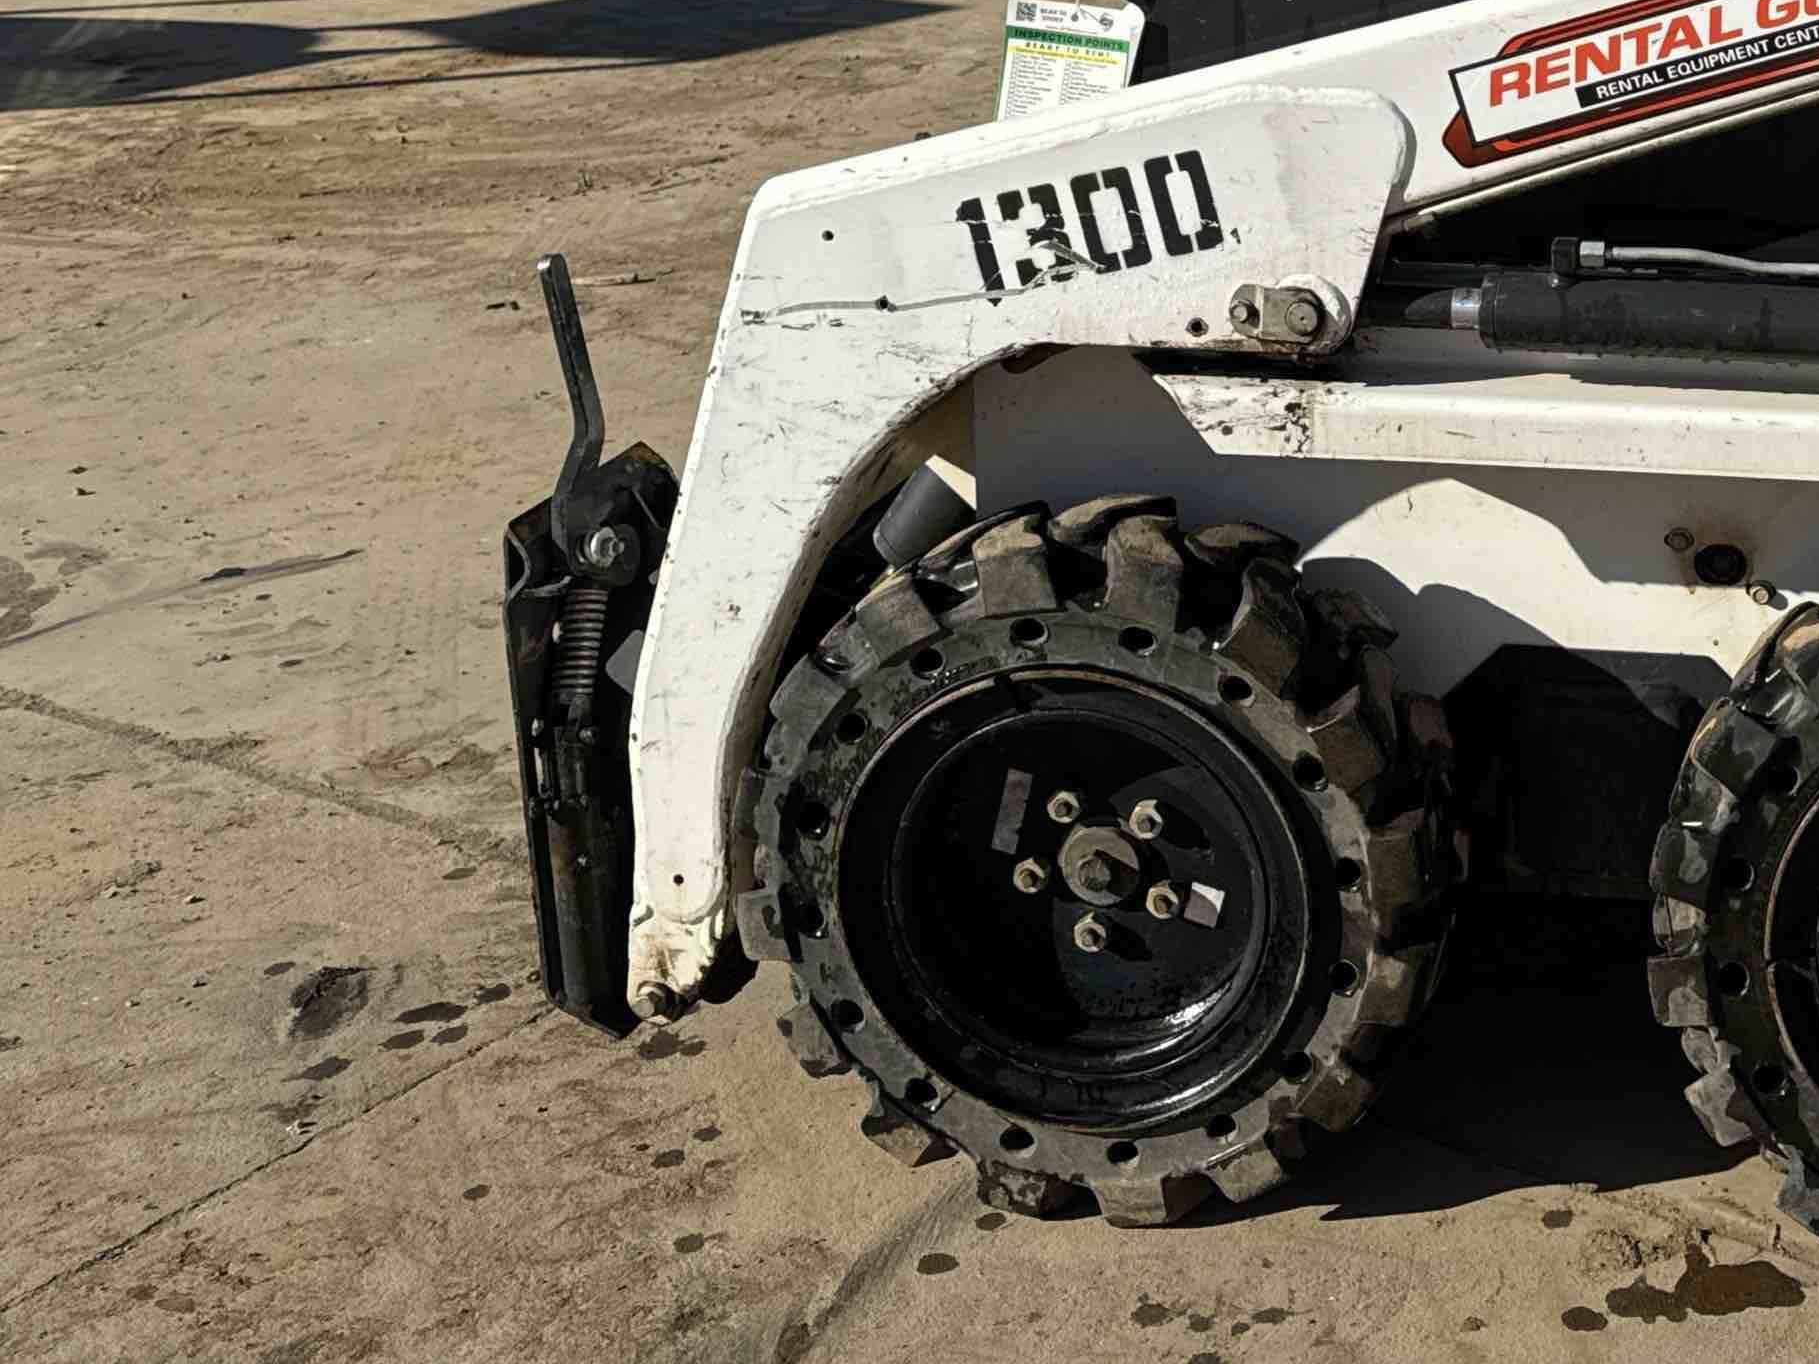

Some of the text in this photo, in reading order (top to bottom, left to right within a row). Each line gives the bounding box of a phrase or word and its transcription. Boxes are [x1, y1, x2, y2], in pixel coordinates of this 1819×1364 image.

[1013, 28, 1083, 46] INSPECTION
[1086, 37, 1124, 51] POINTS
[1489, 4, 1731, 108] RENTAL
[1595, 68, 1664, 101] RENTAL
[1667, 41, 1772, 82] EQUIPMENT
[955, 149, 1225, 308] 1300
